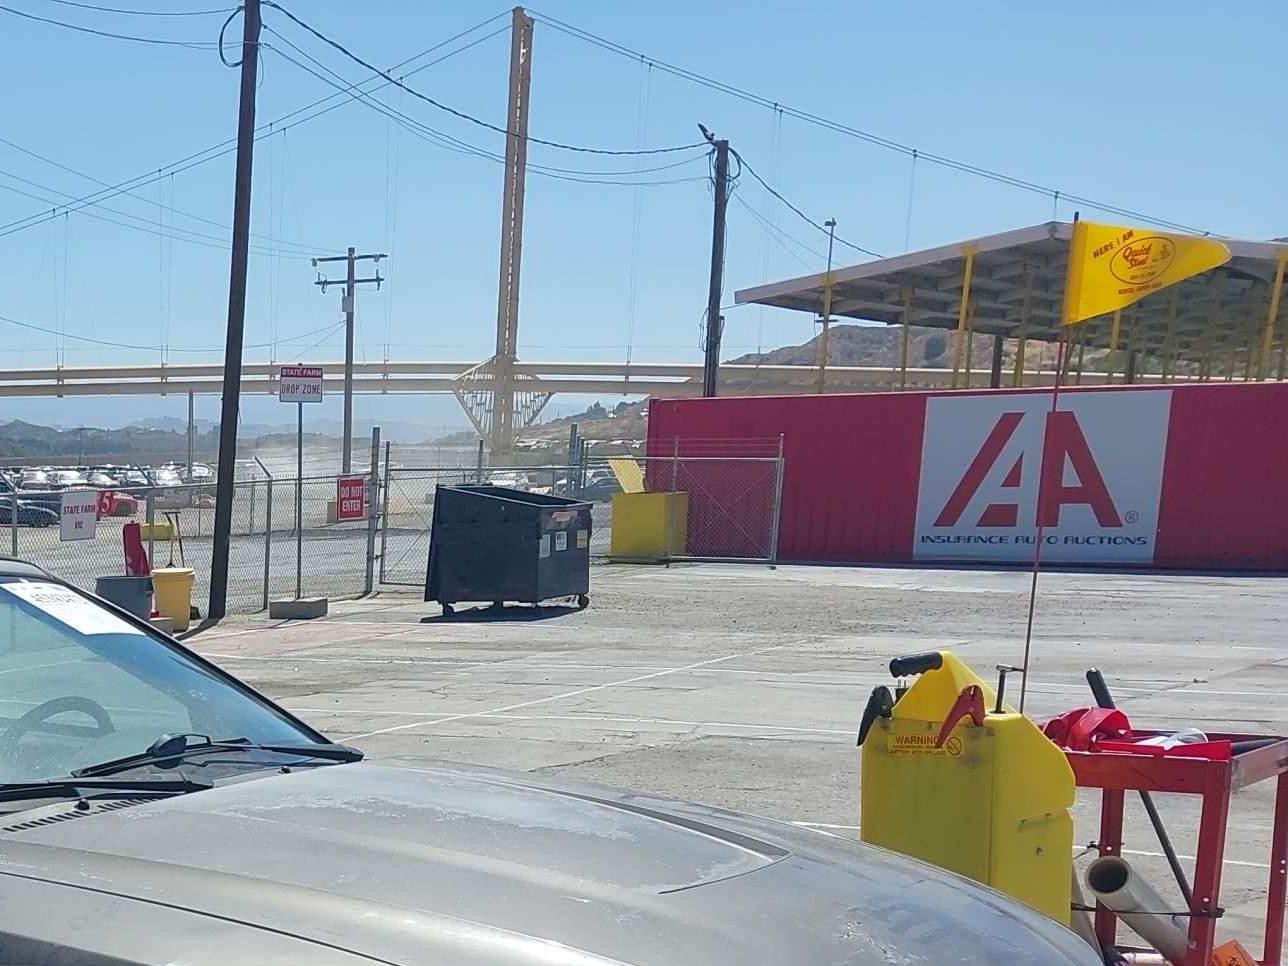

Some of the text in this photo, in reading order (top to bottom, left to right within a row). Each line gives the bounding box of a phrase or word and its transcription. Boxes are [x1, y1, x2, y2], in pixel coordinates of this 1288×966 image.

[1093, 241, 1114, 258] HERE
[1122, 229, 1135, 243] AM
[282, 367, 322, 377] STATE FARM
[281, 383, 321, 395] DROP ZONE
[340, 485, 363, 498] DO NOT
[102, 492, 112, 513] 5
[342, 499, 361, 512] ENTER
[63, 503, 96, 515] STATE FARM
[74, 520, 84, 529] VIC
[921, 535, 1010, 544] INSURANCE
[1063, 536, 1148, 545] AUCTIONS
